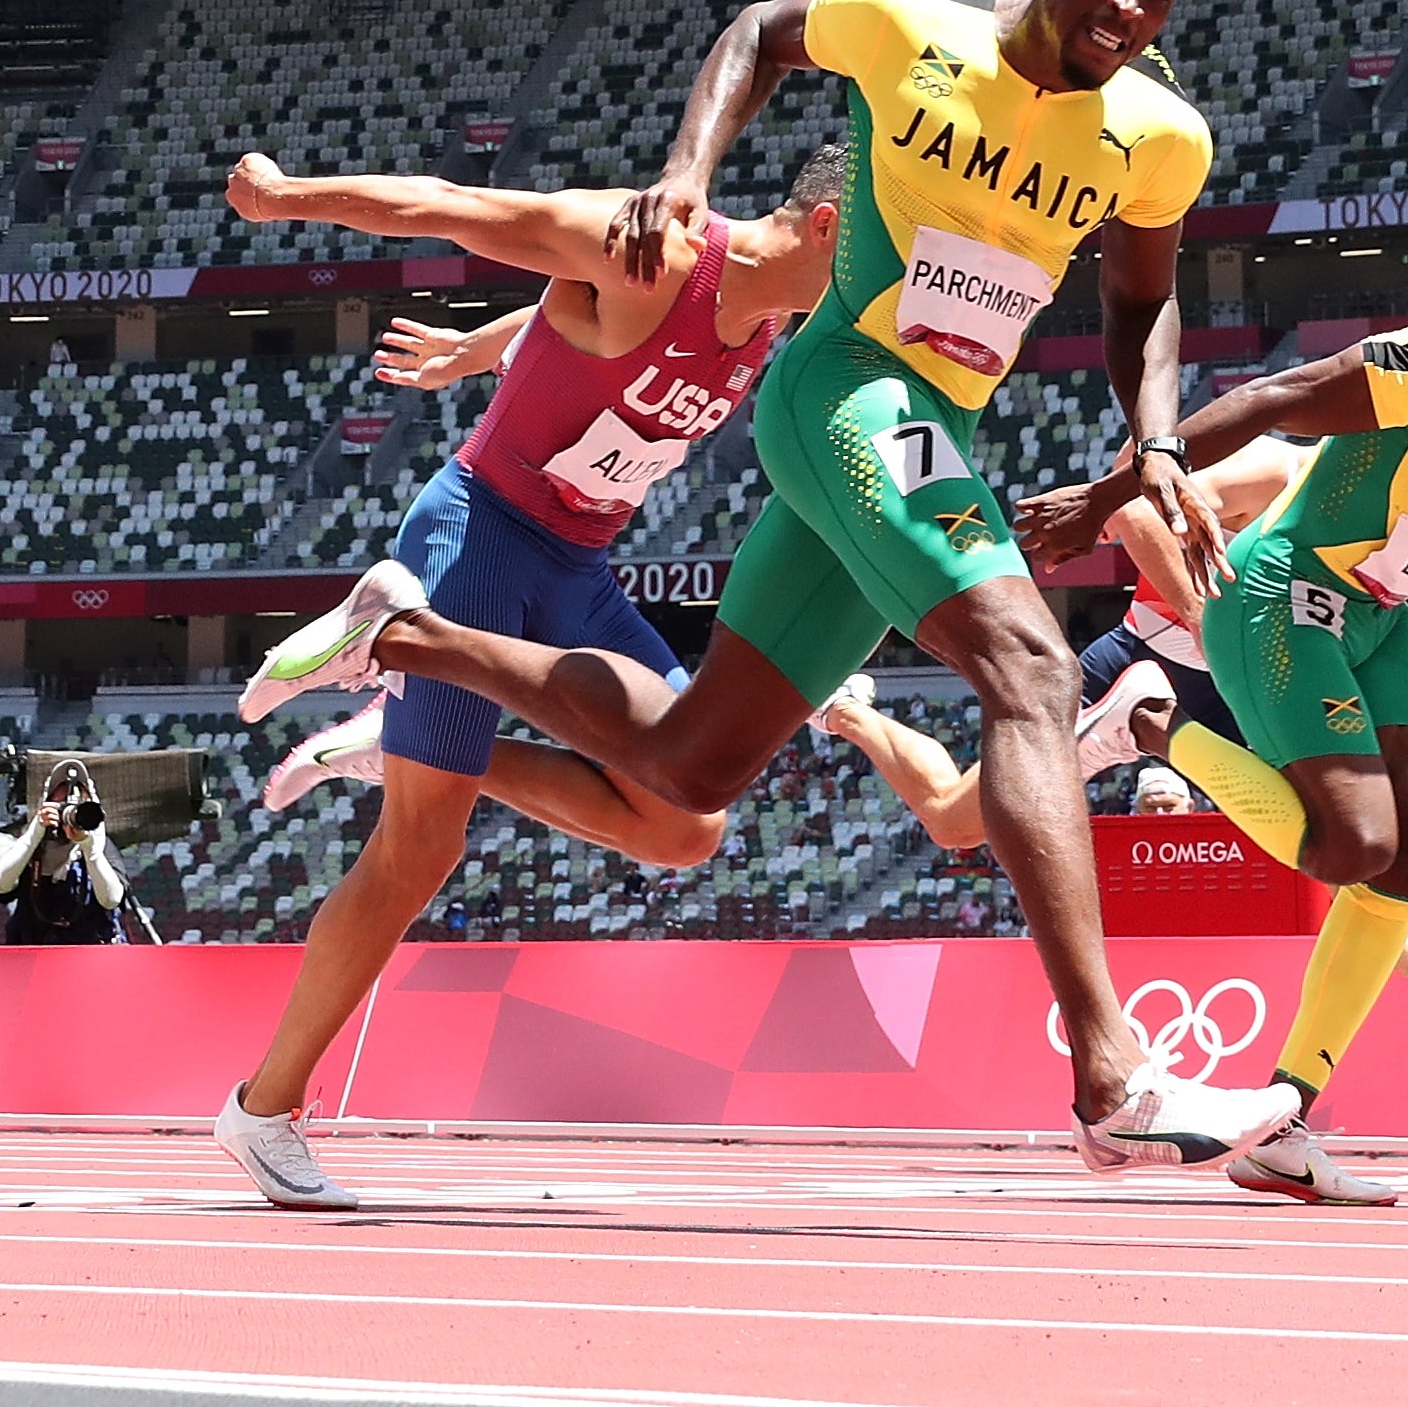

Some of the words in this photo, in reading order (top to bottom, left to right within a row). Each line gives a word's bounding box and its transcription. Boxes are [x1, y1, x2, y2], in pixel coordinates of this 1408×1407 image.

[892, 107, 1119, 230] JAMAICA
[78, 270, 153, 301] 2020
[910, 260, 1041, 321] PARCHMENT
[623, 364, 732, 436] USA
[893, 425, 933, 478] 7
[618, 562, 714, 603] 2020
[1306, 588, 1335, 627] 5
[1158, 841, 1244, 864] OMEGA
